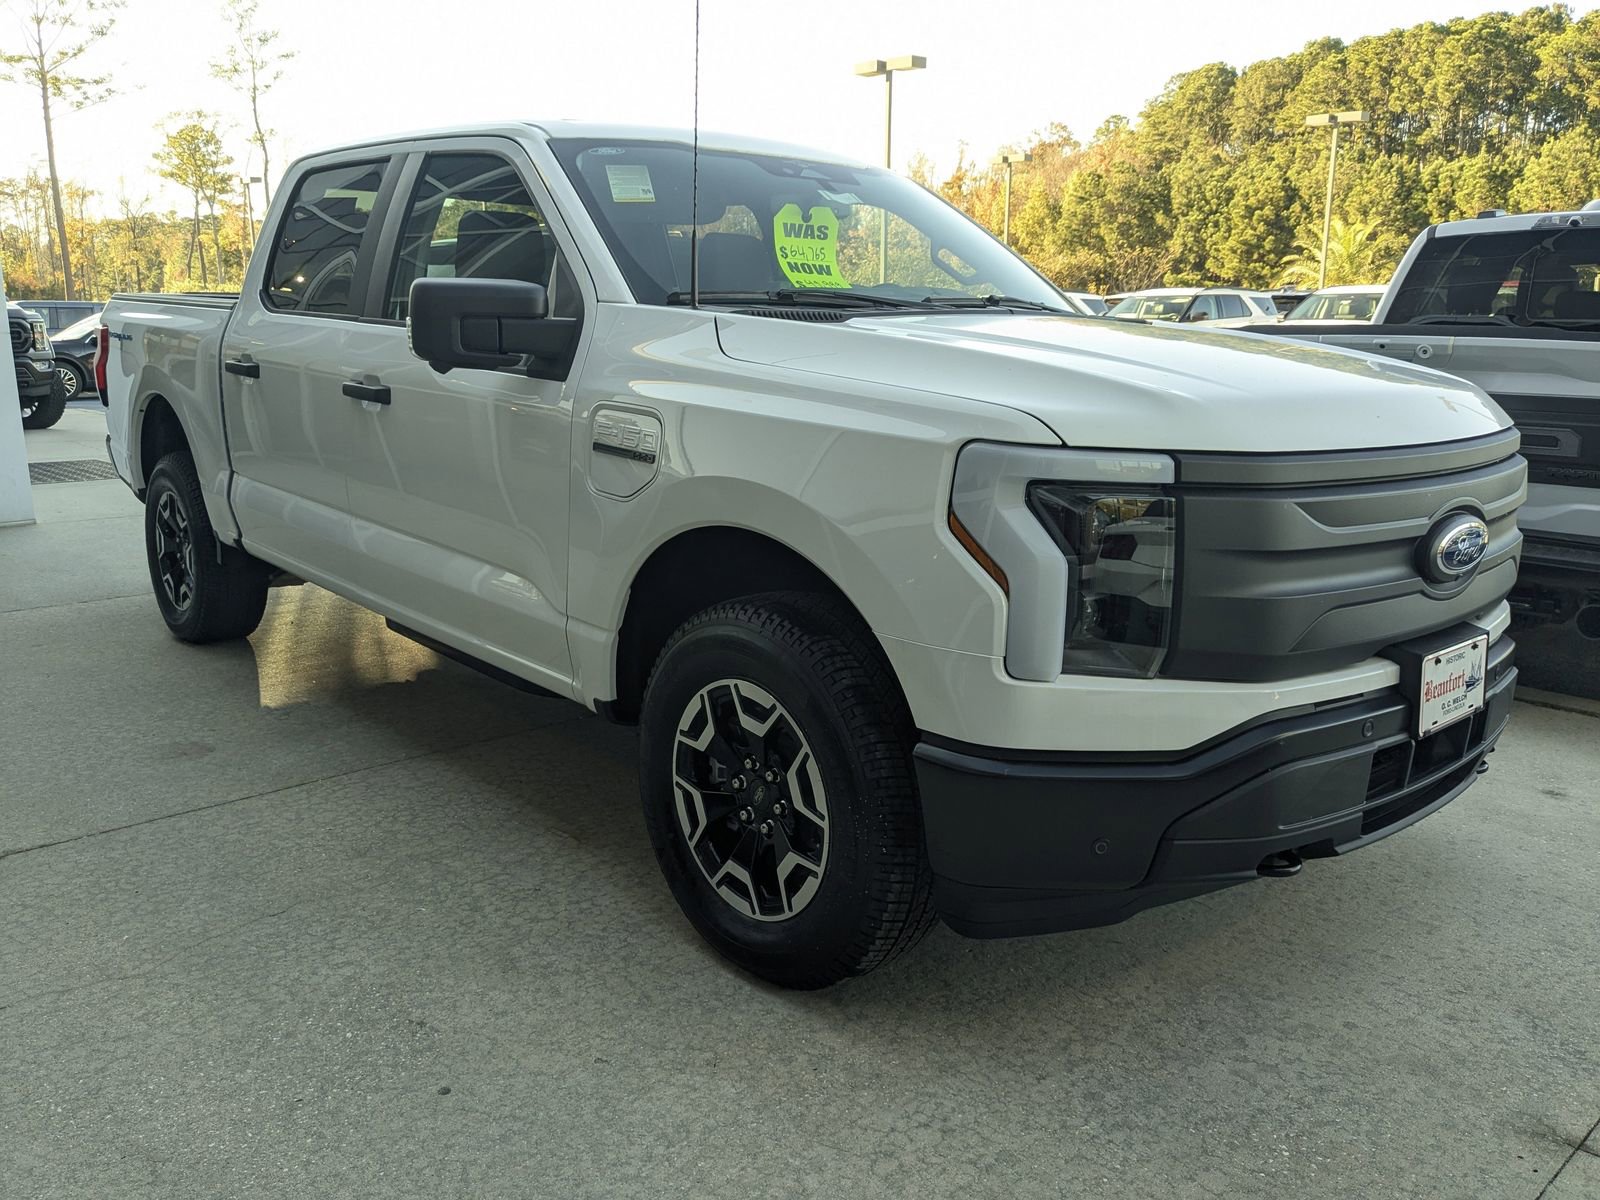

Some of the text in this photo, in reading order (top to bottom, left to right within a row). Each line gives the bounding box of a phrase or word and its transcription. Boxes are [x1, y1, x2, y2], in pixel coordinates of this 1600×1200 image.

[782, 222, 829, 240] WAS
[786, 261, 833, 276] NOW
[1453, 534, 1484, 561] Ford
[1446, 651, 1466, 664] HISTORIC
[1424, 669, 1466, 703] Beaufort
